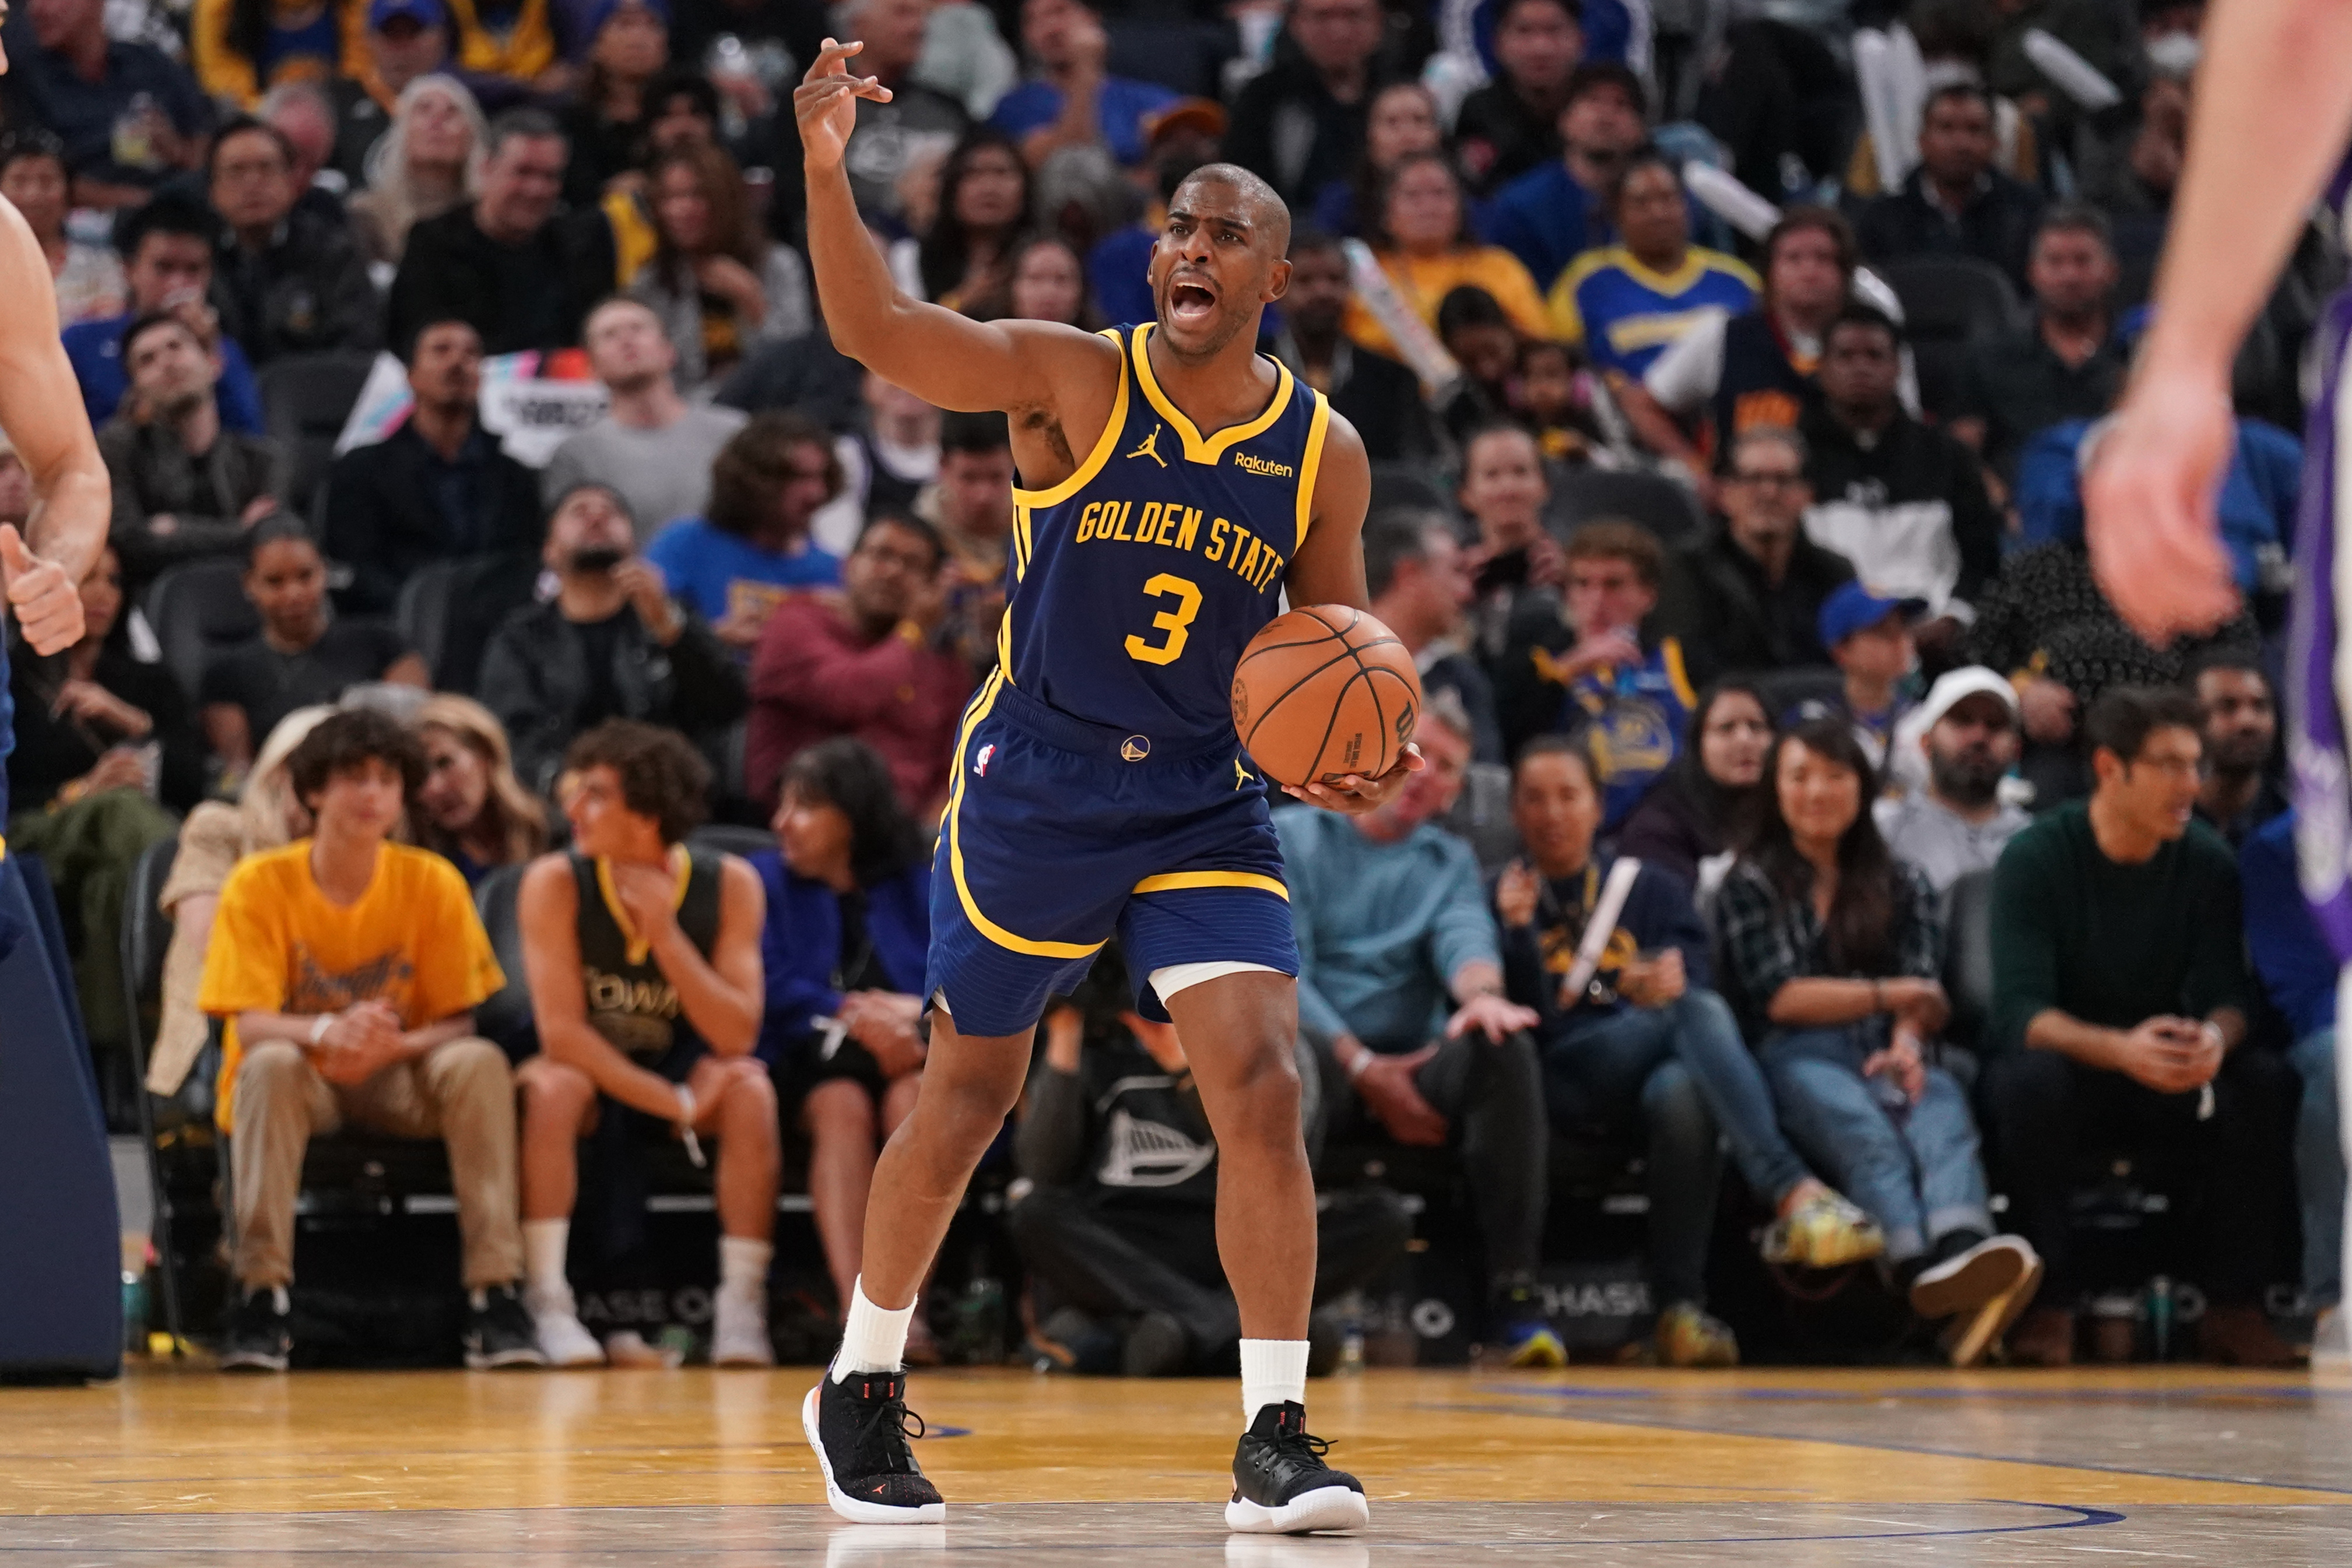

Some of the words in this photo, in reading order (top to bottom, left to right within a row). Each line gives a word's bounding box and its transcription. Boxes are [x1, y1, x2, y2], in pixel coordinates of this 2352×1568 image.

[1235, 452, 1293, 477] Rakuten
[1076, 501, 1203, 551] GOLDEN
[1205, 518, 1284, 594] STATE
[1124, 572, 1203, 666] 3
